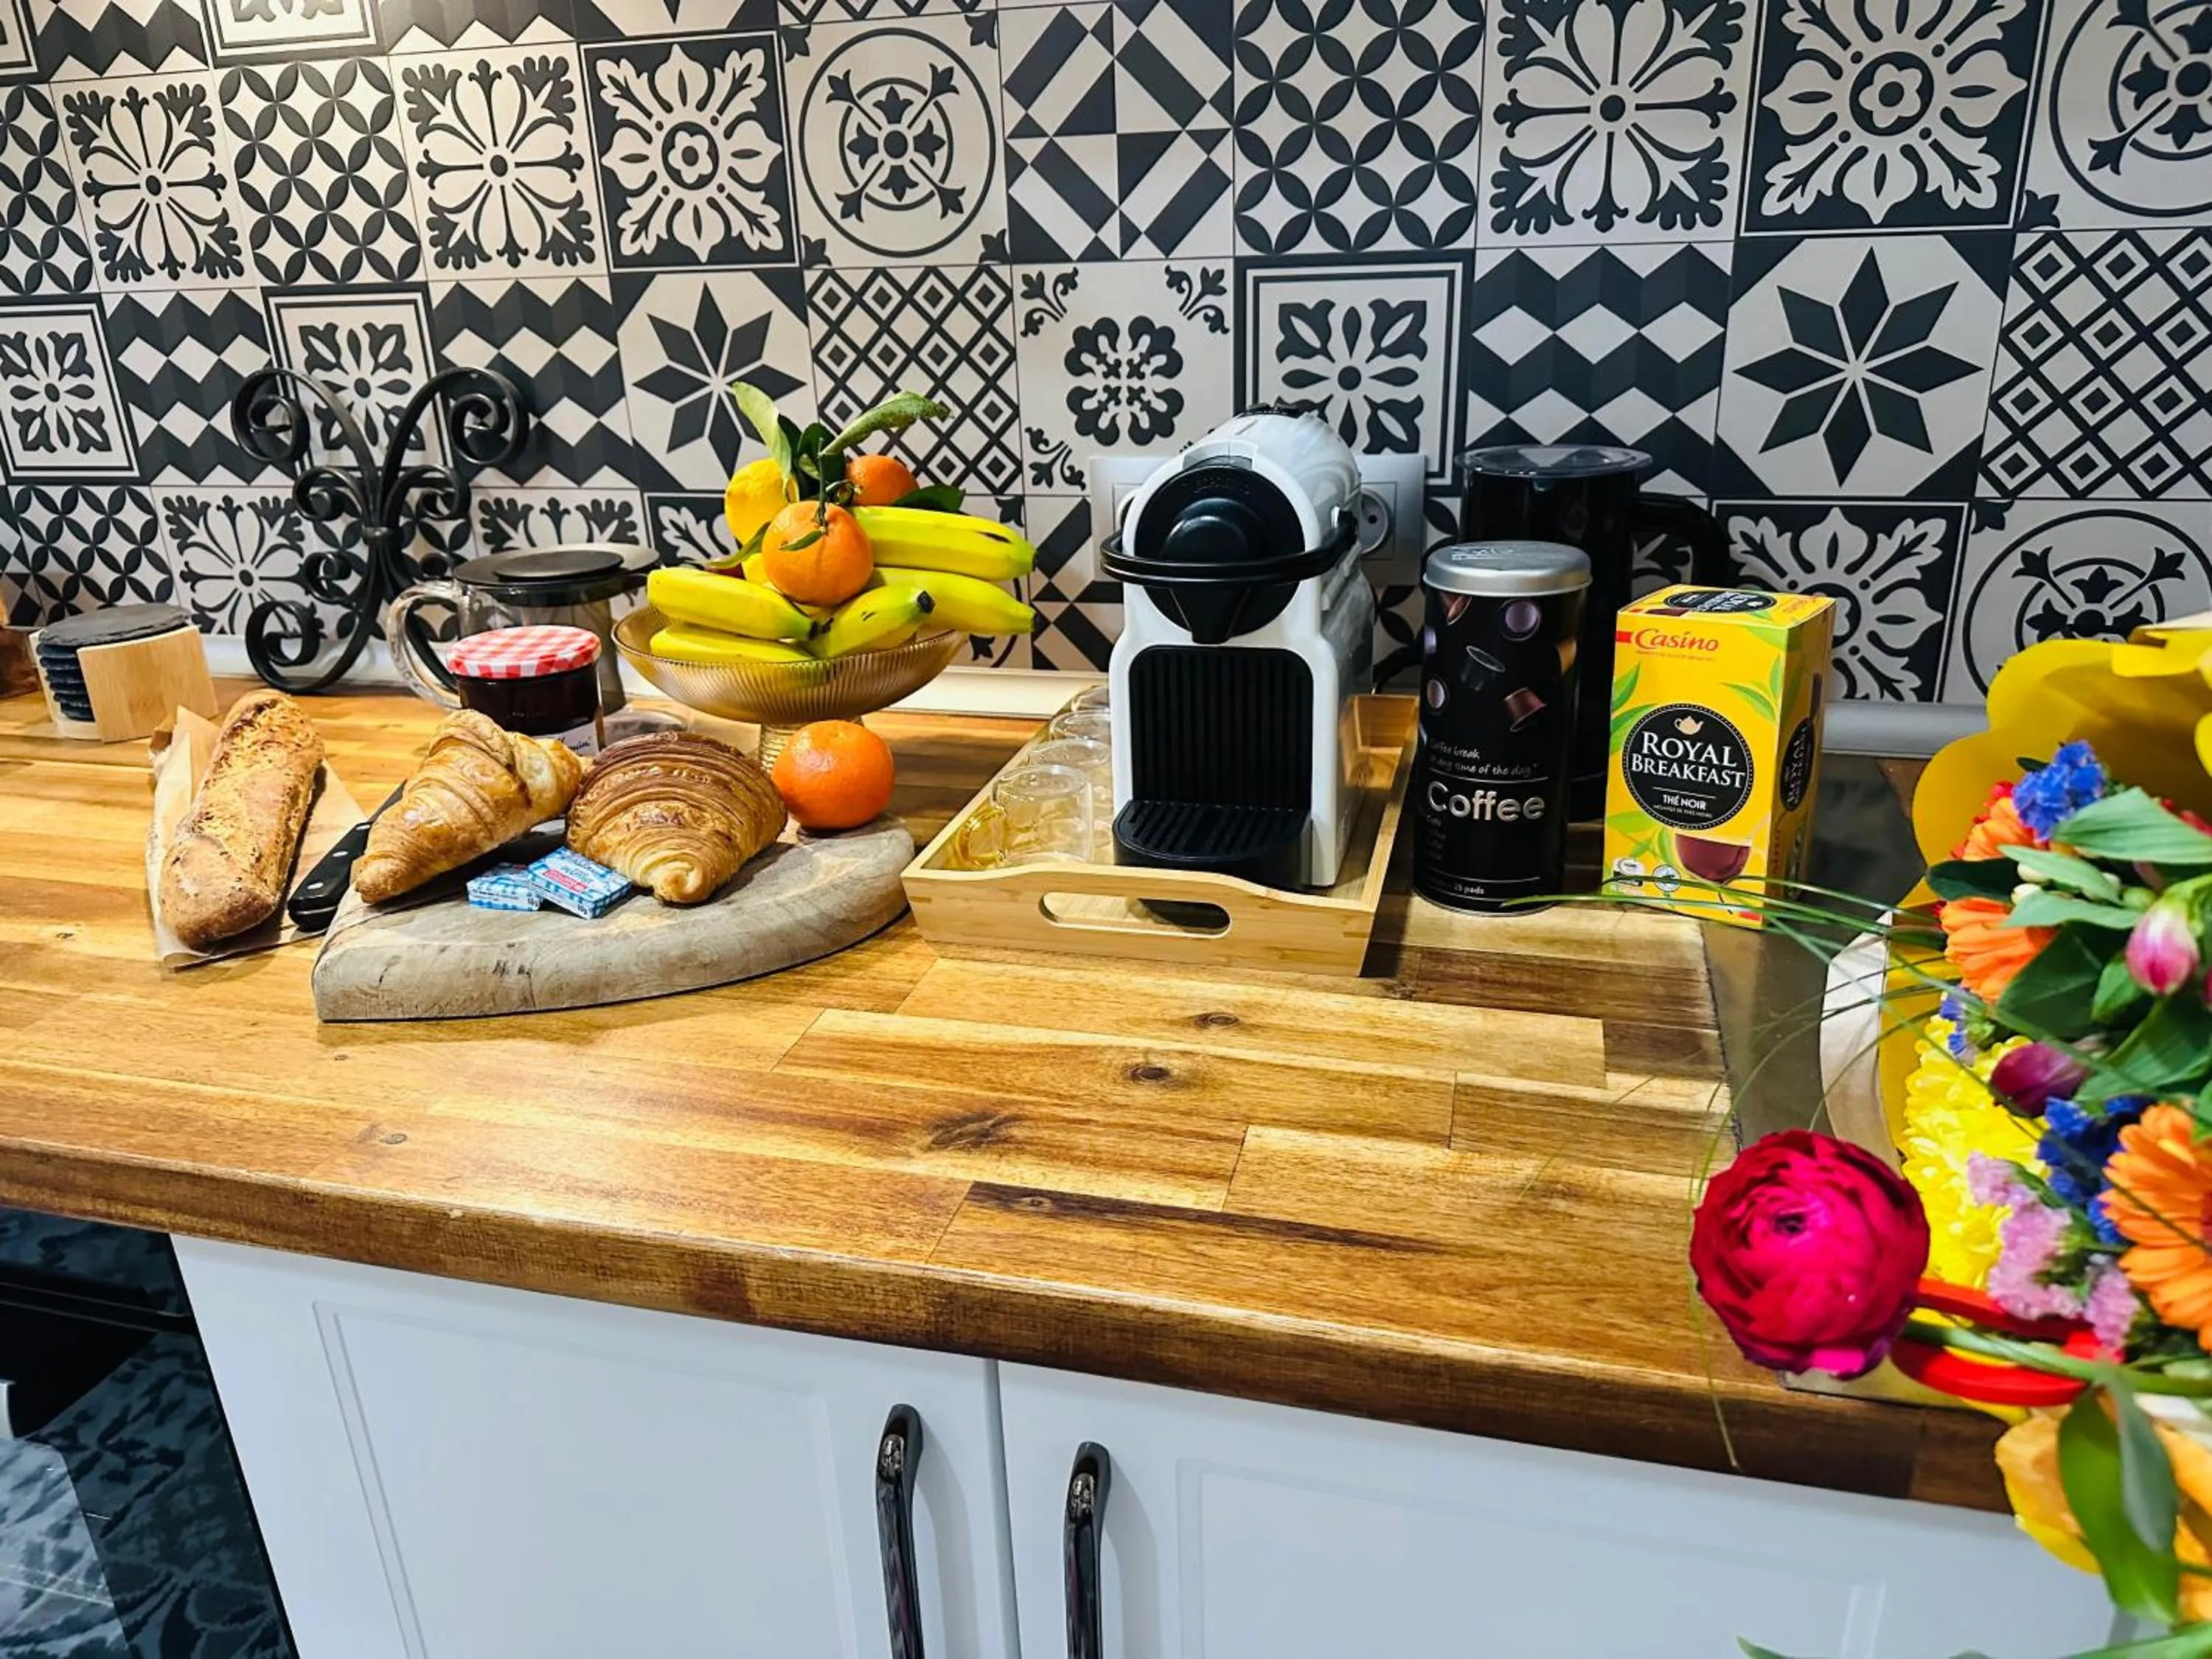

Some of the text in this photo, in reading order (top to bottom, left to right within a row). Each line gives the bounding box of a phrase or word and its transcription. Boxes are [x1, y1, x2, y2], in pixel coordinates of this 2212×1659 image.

[1635, 628, 1719, 651] Casino
[1641, 731, 1737, 767] ROYAL
[1478, 763, 1491, 774] of
[1492, 764, 1509, 775] the
[1631, 753, 1745, 788] BREAKFAST
[1427, 780, 1545, 822] Coffee
[1663, 794, 1707, 810] THÉ NOIR
[1464, 886, 1485, 894] pads
